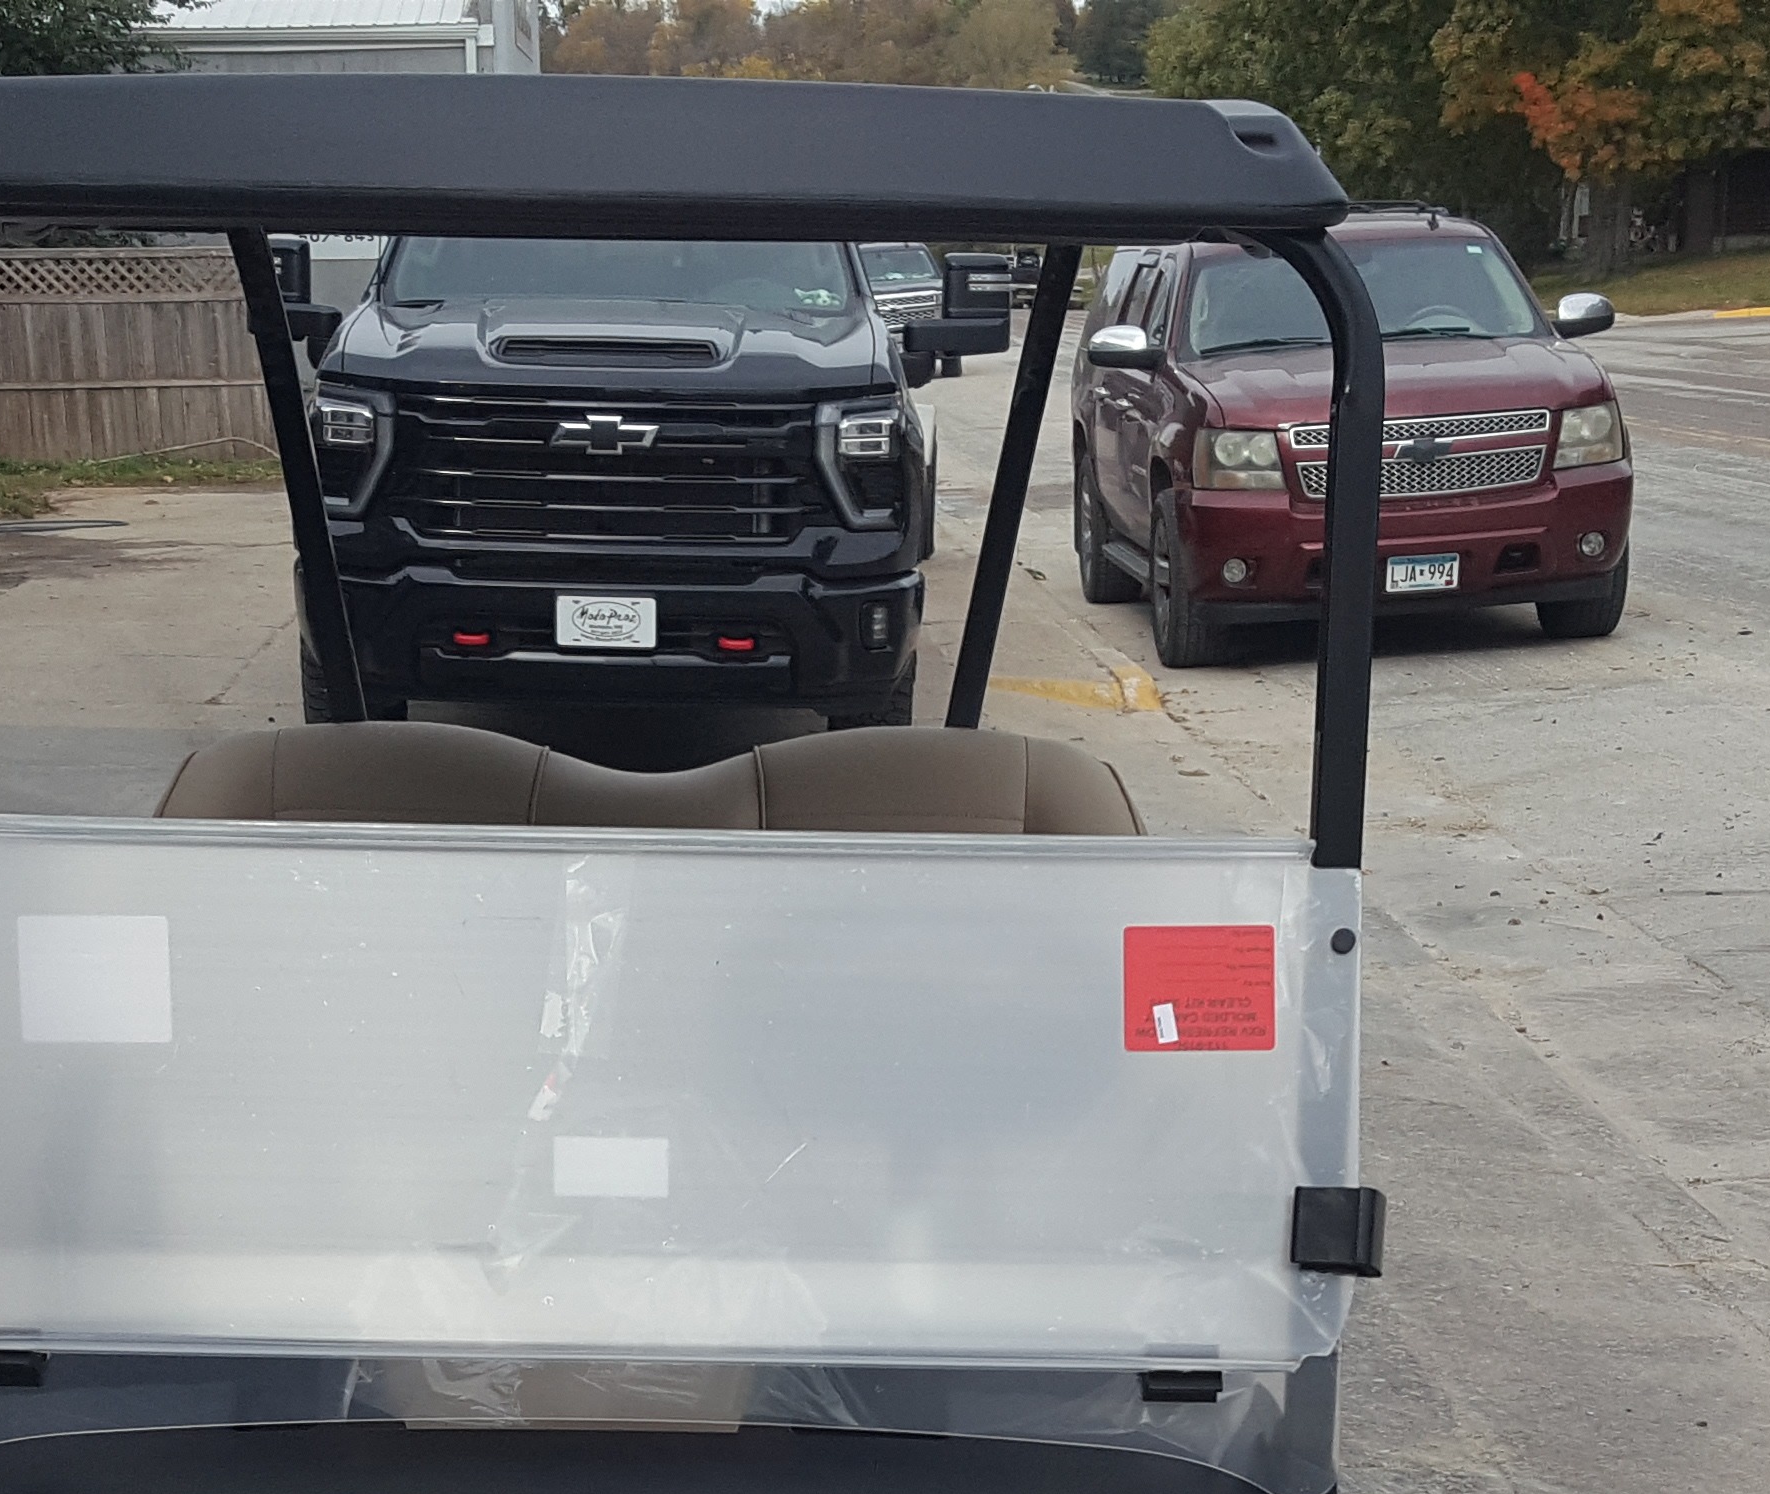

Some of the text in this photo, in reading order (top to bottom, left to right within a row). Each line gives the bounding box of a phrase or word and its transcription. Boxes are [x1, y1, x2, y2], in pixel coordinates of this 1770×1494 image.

[1391, 562, 1454, 583] LJA 994
[1203, 1012, 1257, 1022] MOLDED
